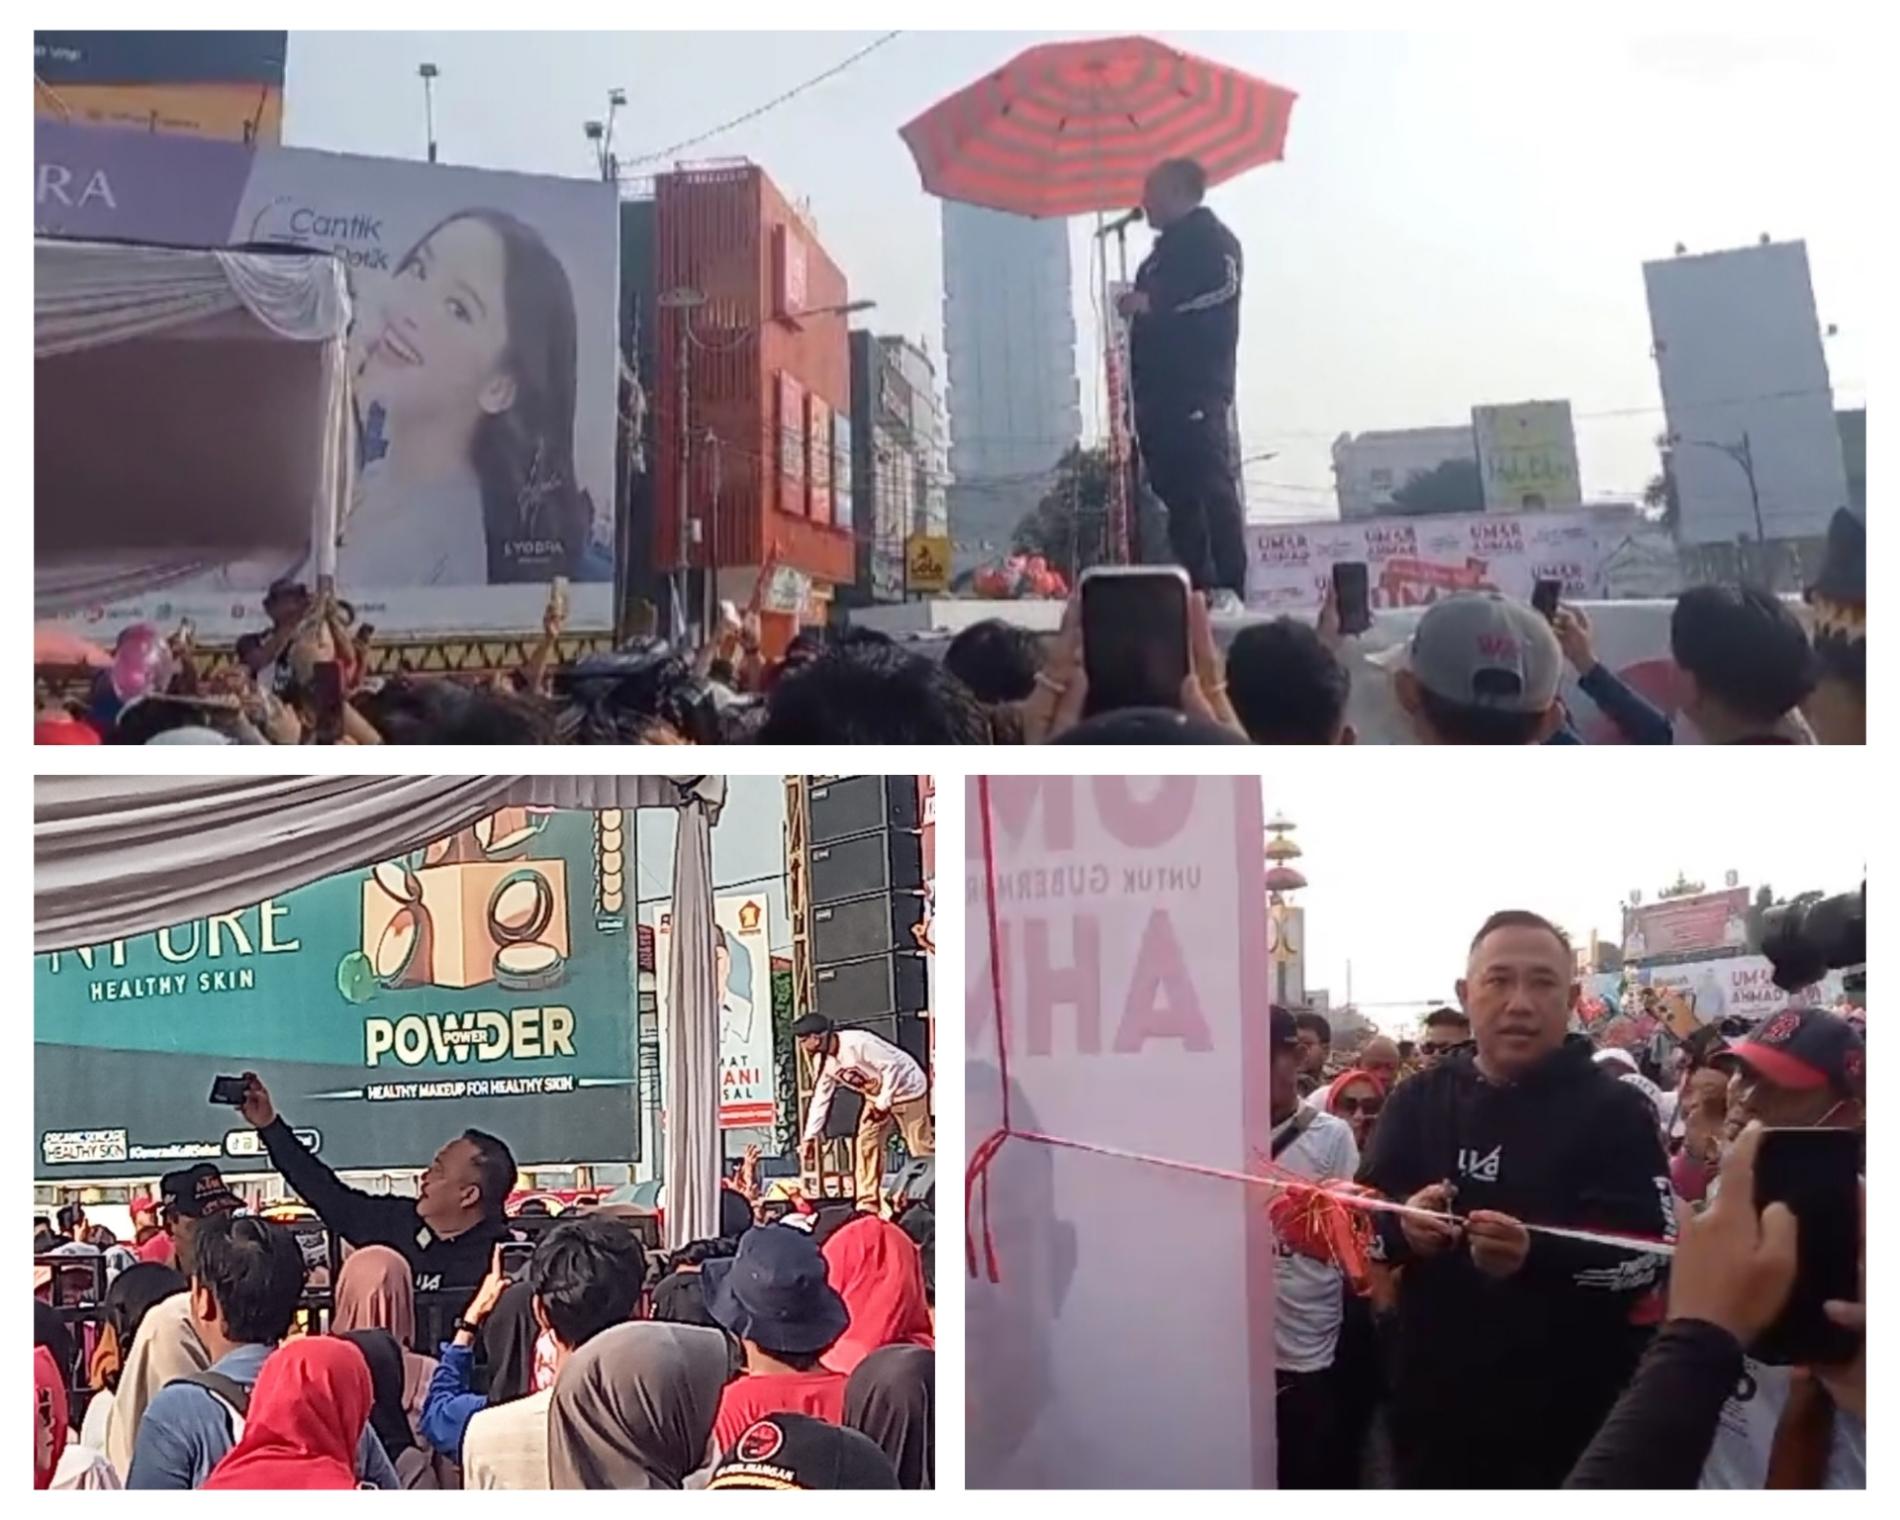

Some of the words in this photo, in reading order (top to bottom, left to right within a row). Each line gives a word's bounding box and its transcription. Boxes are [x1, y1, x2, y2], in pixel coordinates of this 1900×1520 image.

[290, 208, 382, 241] Cantik
[90, 974, 186, 1001] HEALTHY
[199, 969, 255, 991] SKIN
[366, 1006, 576, 1067] POWDER
[443, 1029, 488, 1045] POWER
[368, 1083, 417, 1100] HEALTHY
[419, 1082, 466, 1098] MAKEUP
[467, 1081, 489, 1097] FOR
[490, 1080, 543, 1096] HEALTHY
[544, 1076, 574, 1092] SKIN
